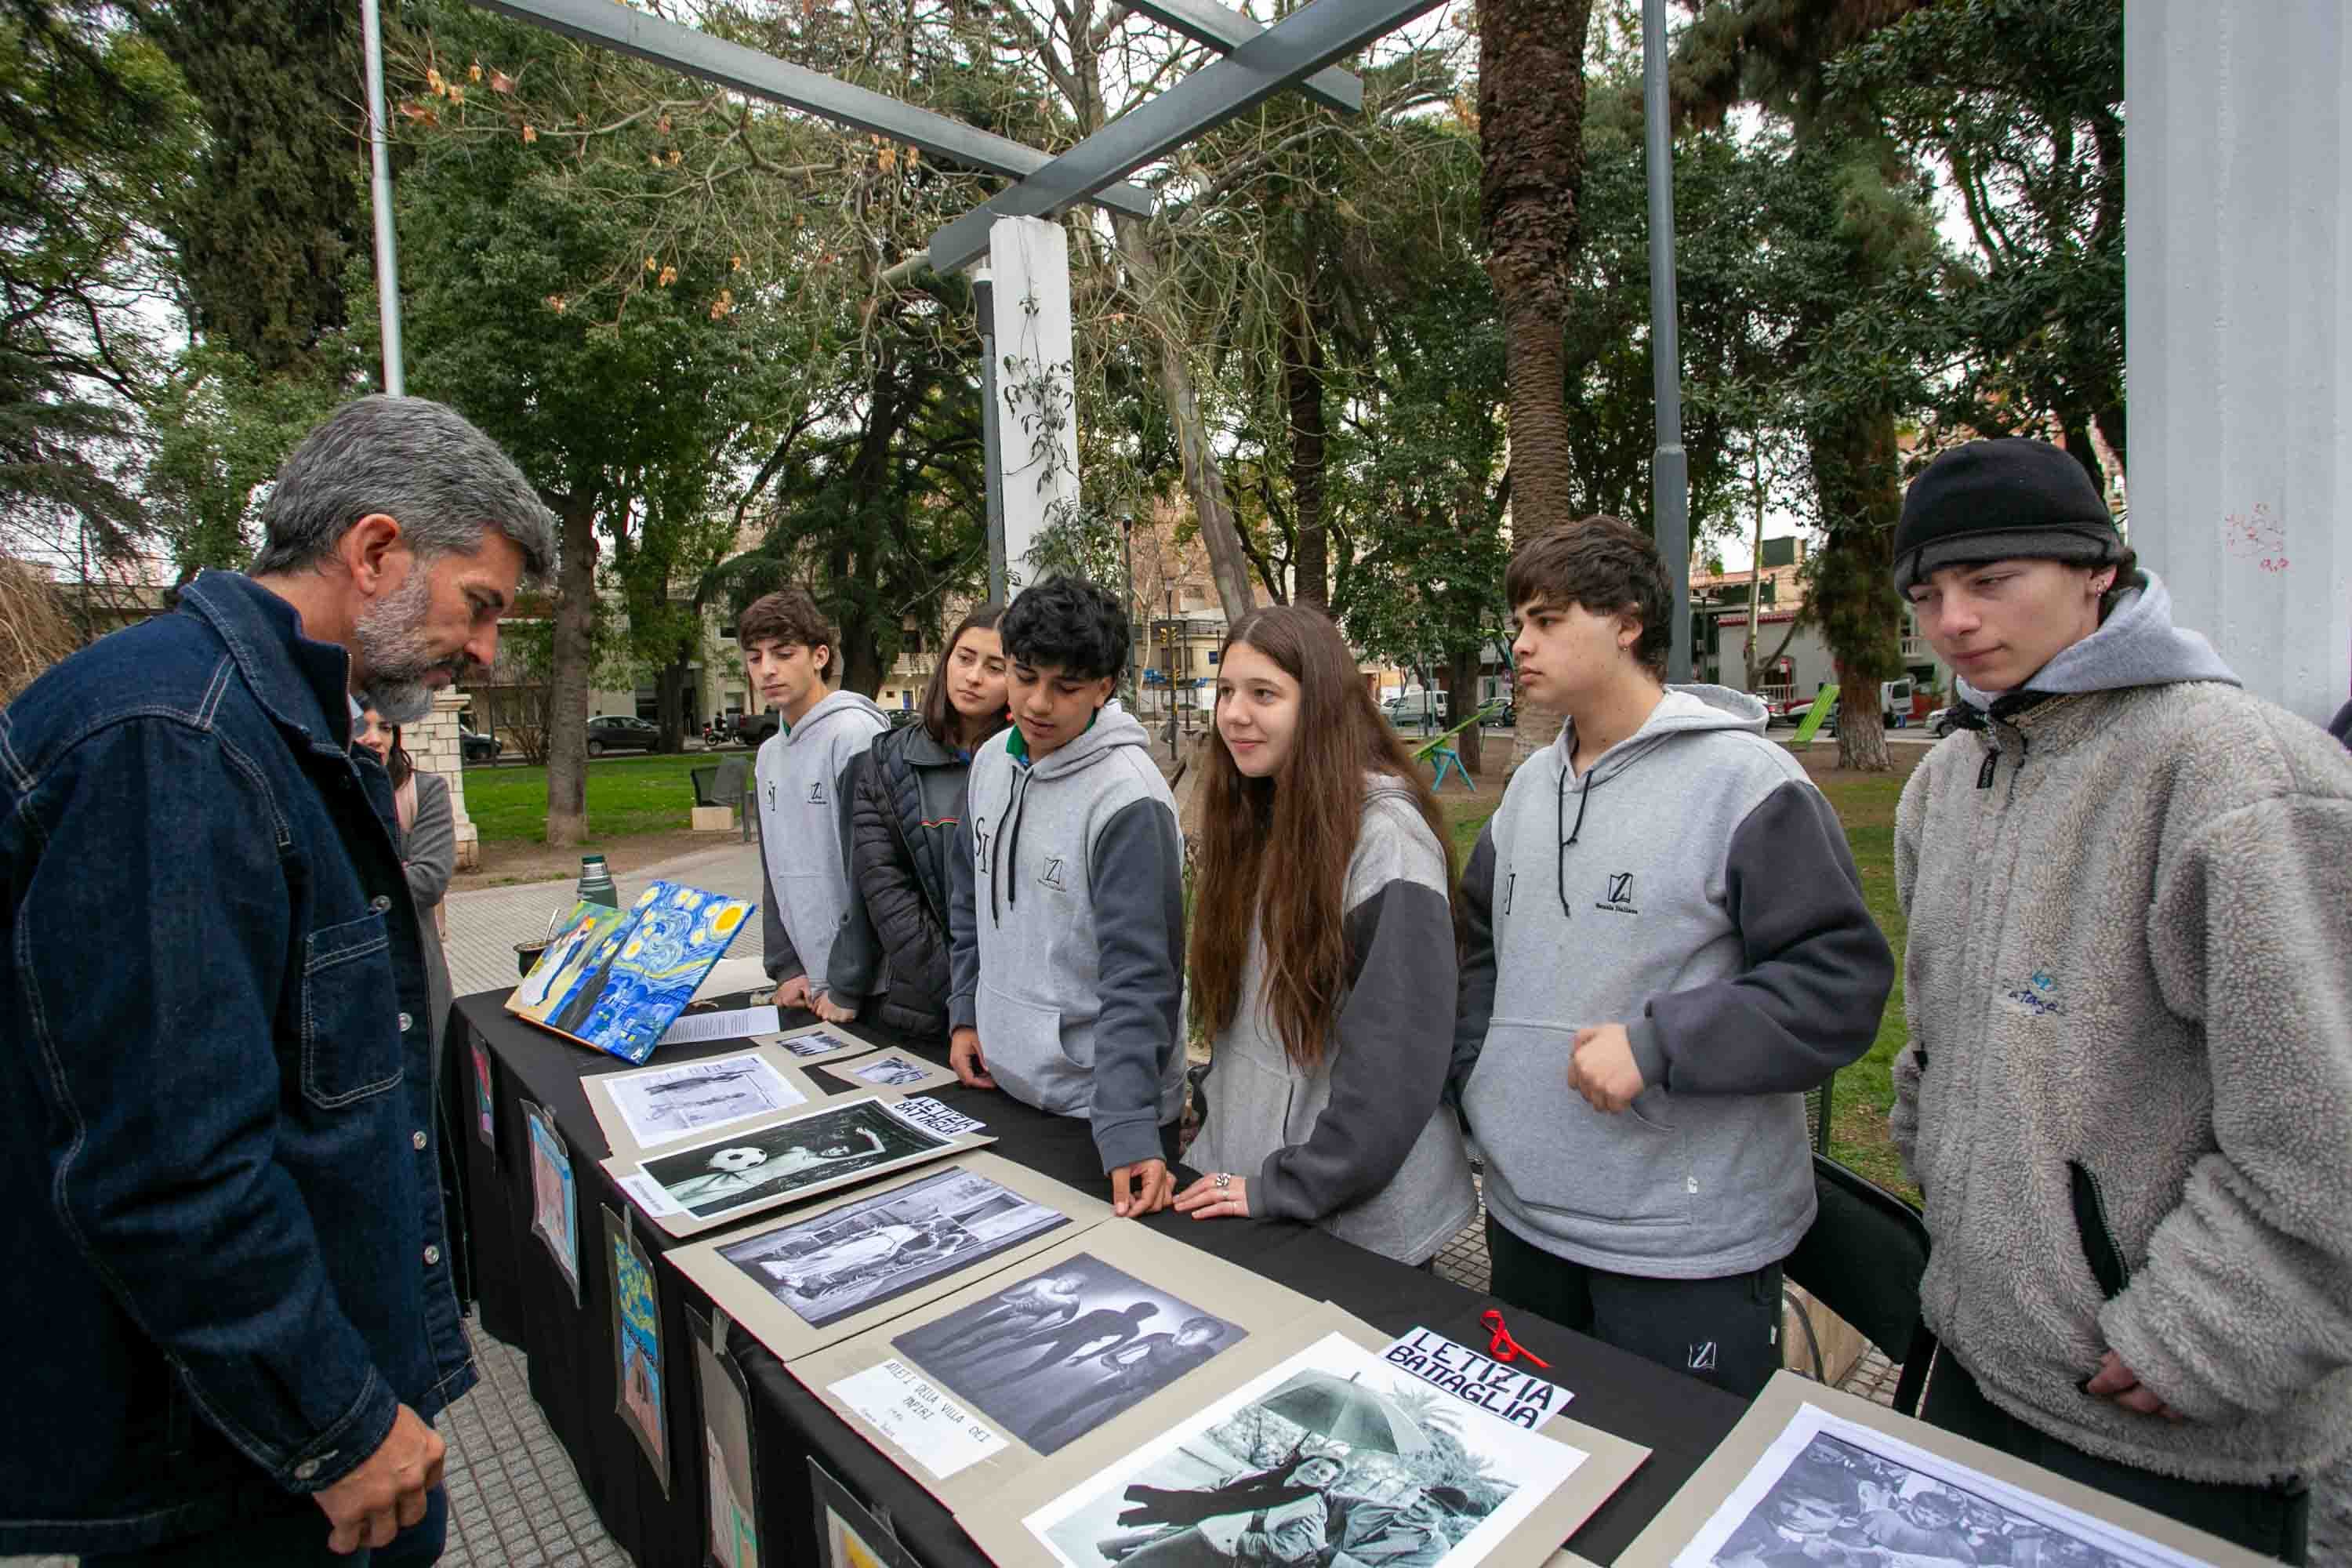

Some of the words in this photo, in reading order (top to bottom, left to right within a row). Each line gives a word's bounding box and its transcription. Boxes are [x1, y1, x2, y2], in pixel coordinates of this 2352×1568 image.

[895, 1102, 962, 1135] BATTAGLIA
[916, 1098, 976, 1129] LETIZIA
[1385, 1345, 1539, 1429] BATTAGLIA
[1411, 1331, 1555, 1410] LETIZIA
[941, 1403, 965, 1423] VILLA
[968, 1425, 990, 1443] DEI
